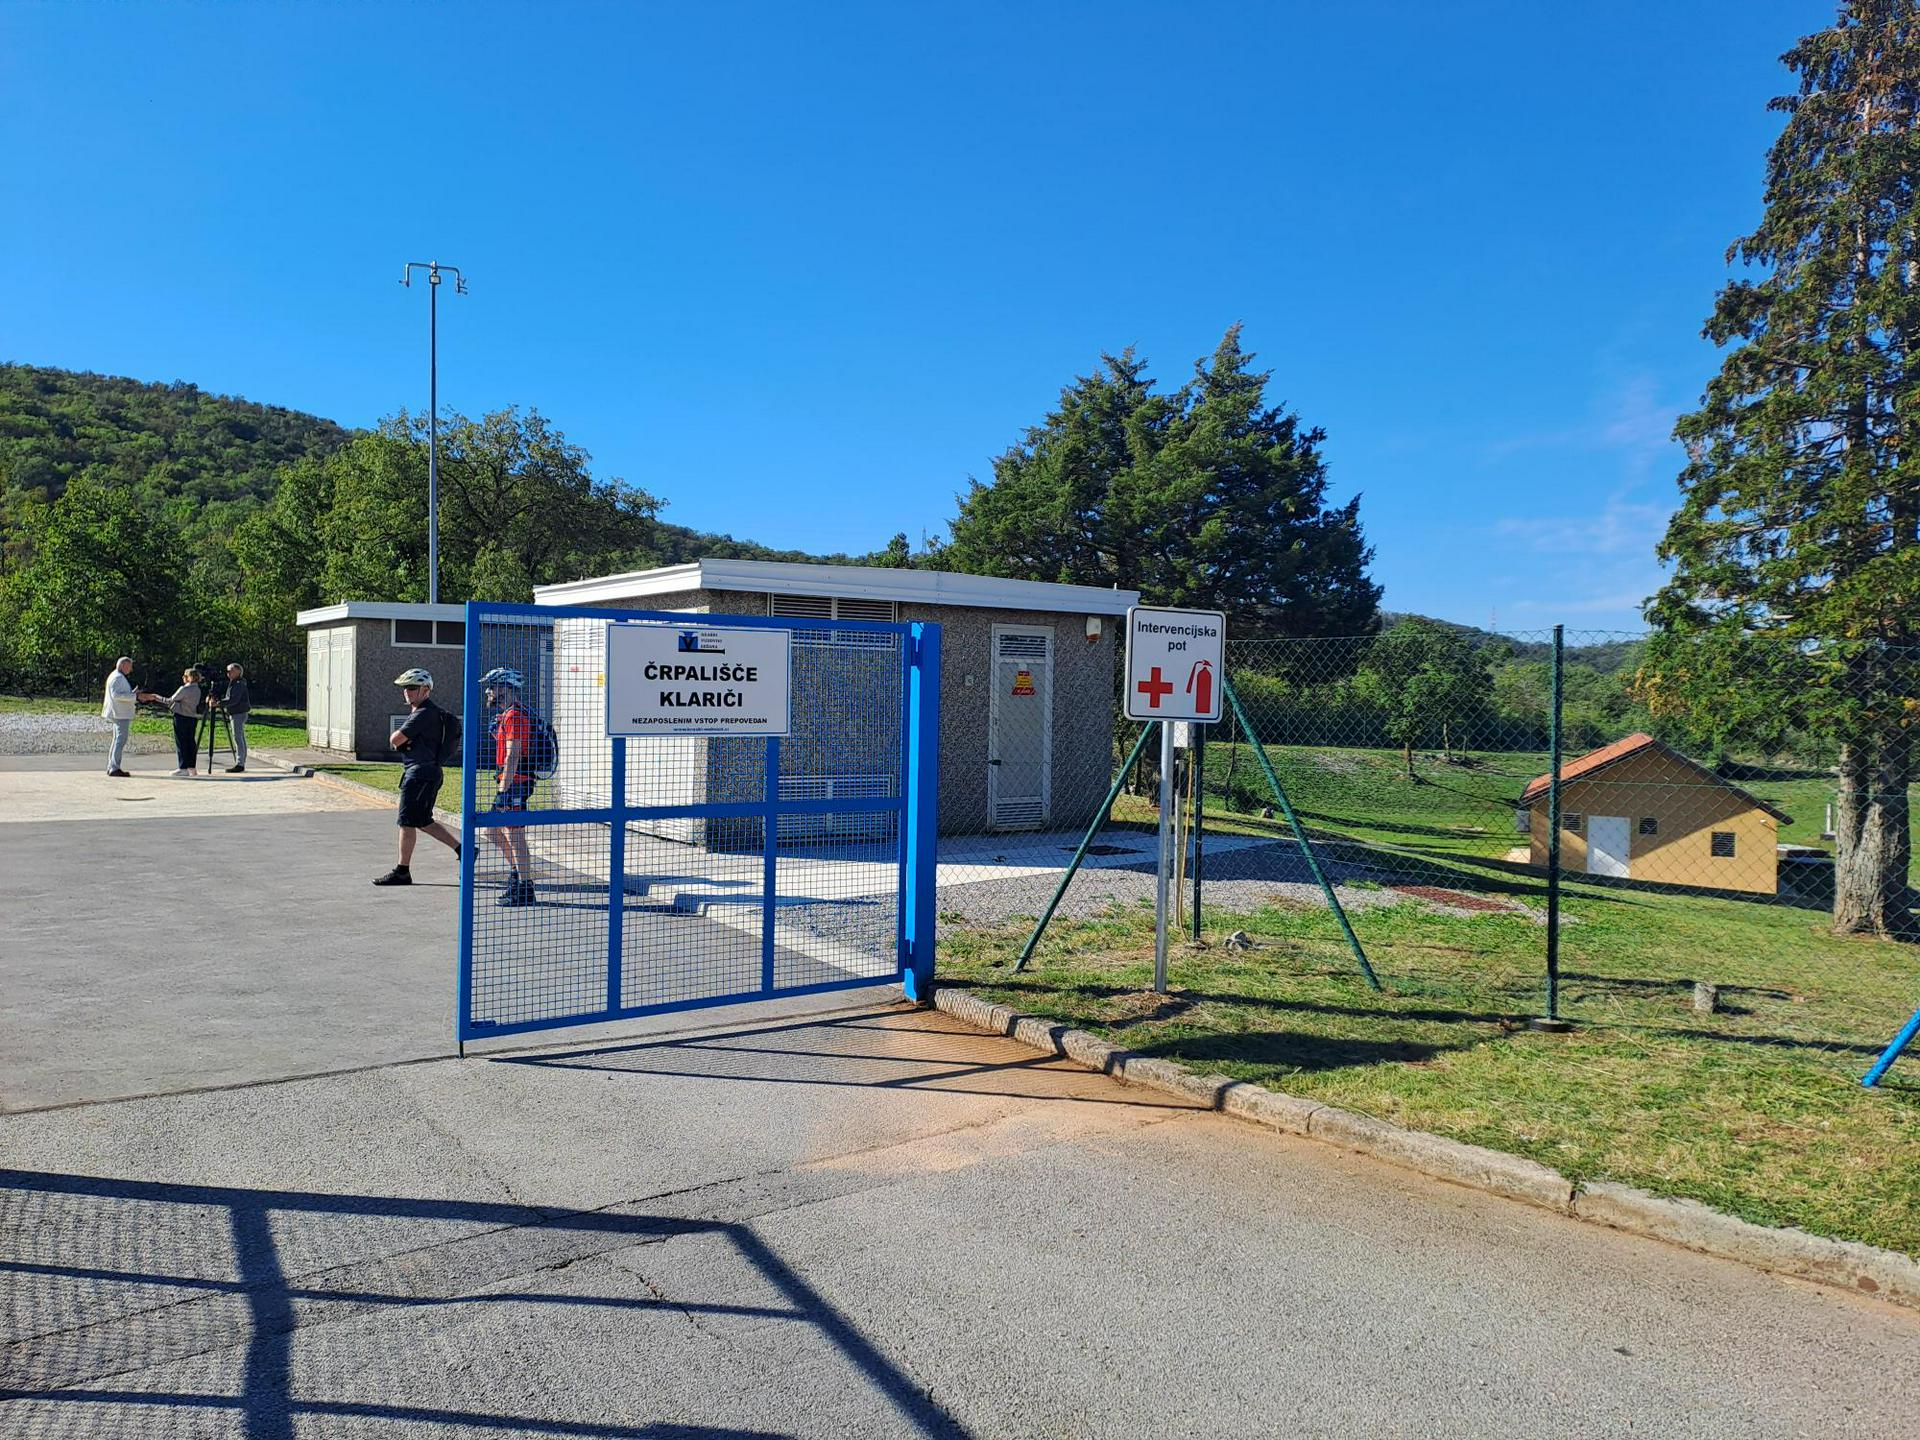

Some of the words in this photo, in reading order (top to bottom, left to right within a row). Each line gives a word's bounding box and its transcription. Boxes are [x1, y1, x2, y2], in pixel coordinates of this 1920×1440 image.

[1137, 621, 1217, 639] Intervencijska
[1168, 641, 1187, 652] pot
[644, 661, 758, 682] ČRPALIŠČE
[660, 689, 743, 707] KLARIČI
